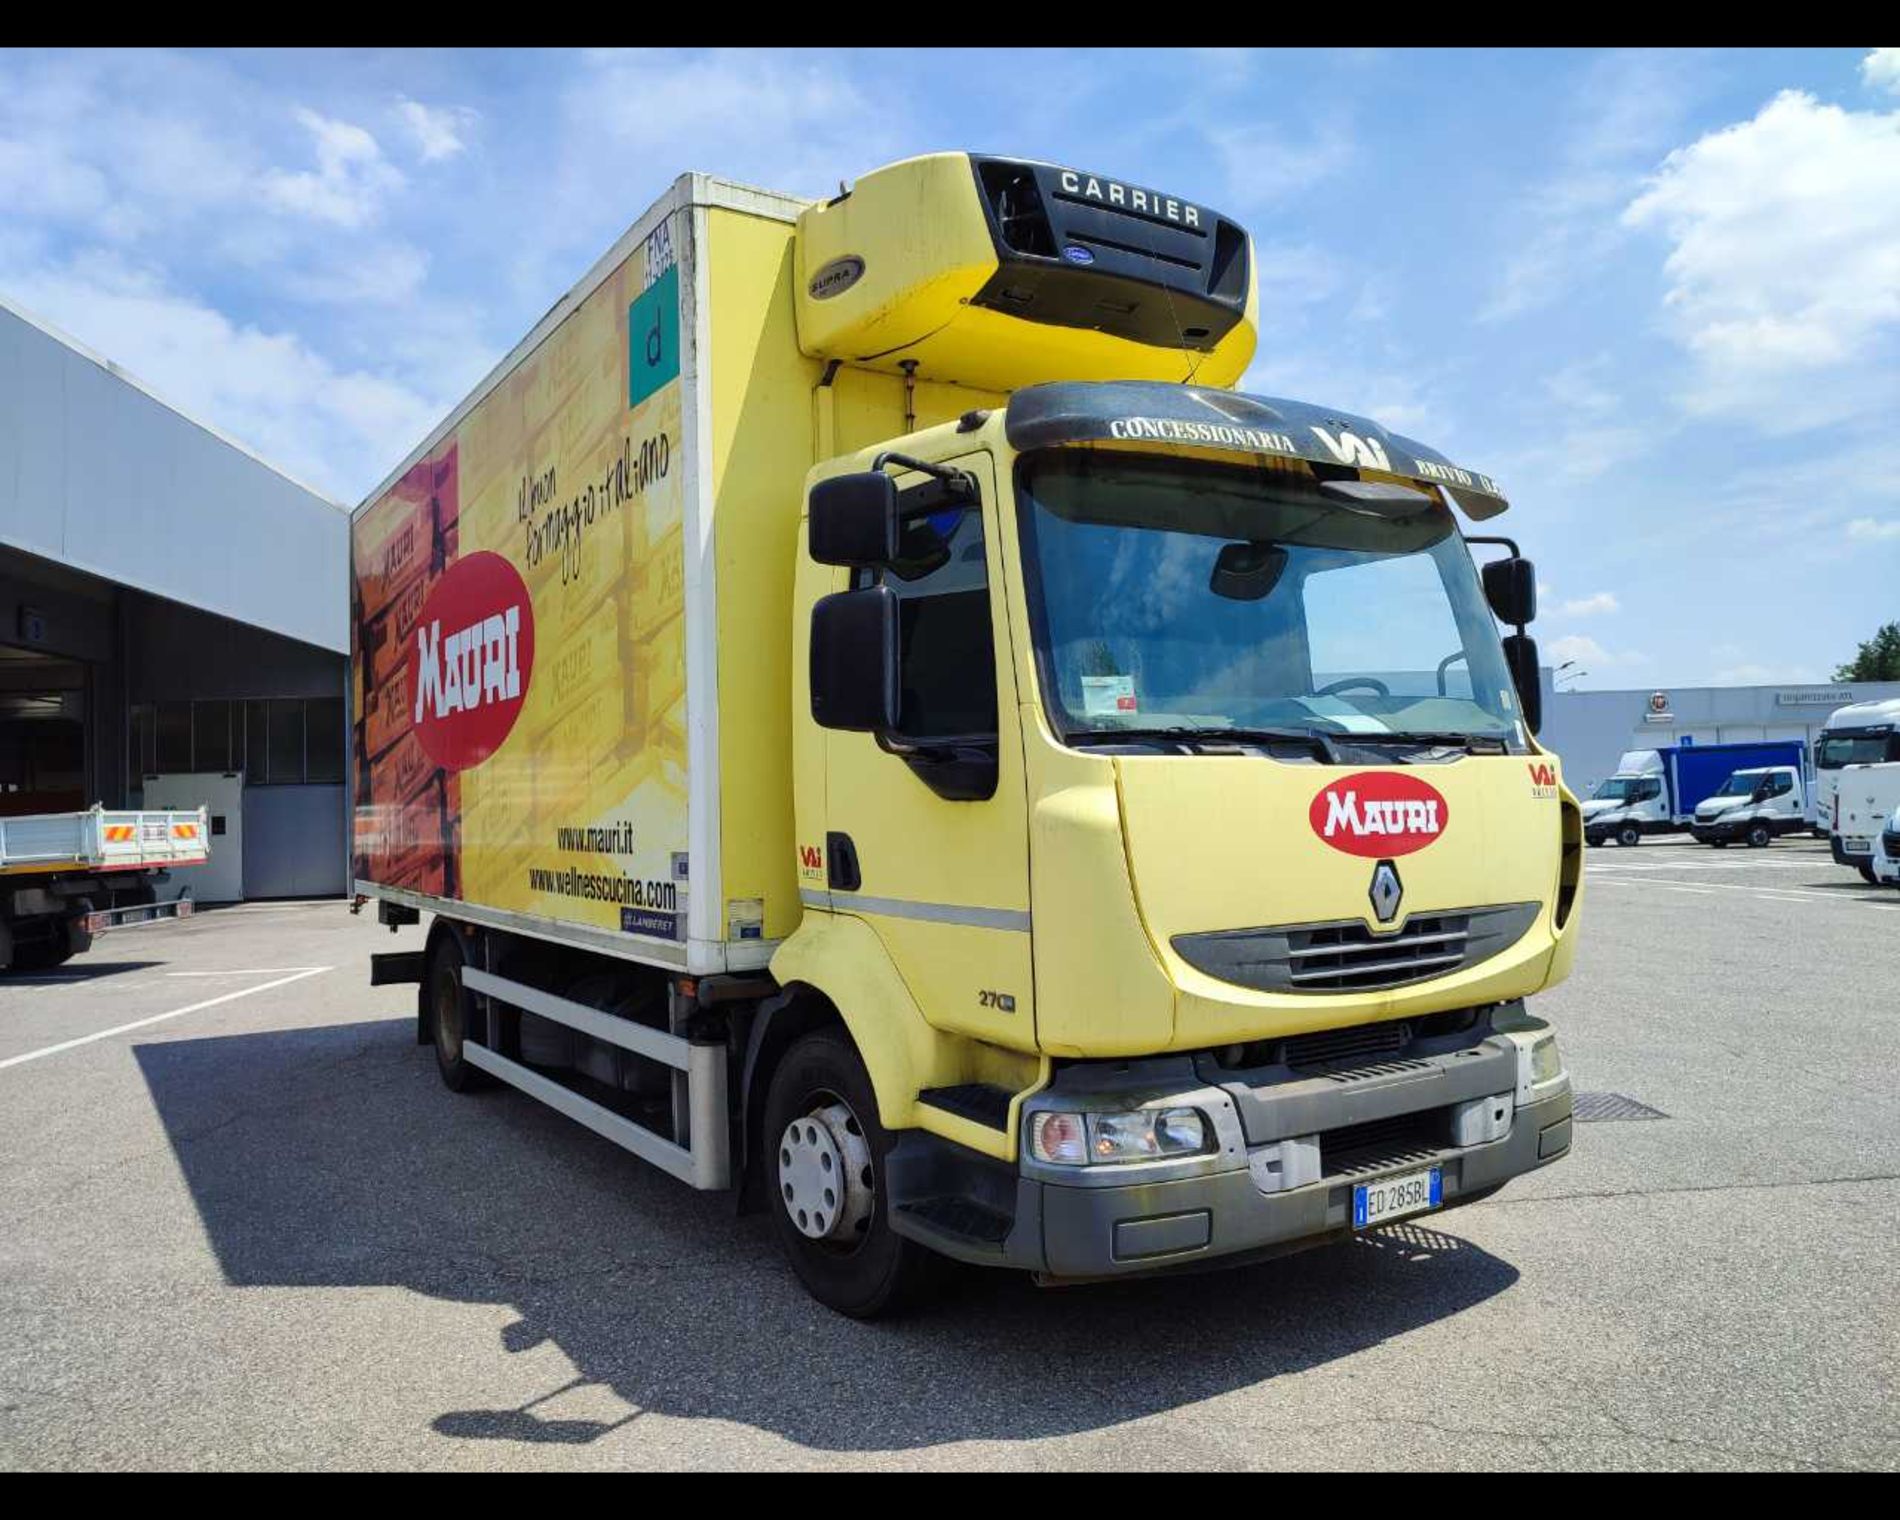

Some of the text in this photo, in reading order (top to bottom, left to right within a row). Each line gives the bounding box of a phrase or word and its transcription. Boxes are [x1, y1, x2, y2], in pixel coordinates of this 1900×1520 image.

[1061, 171, 1199, 226] CARRIER
[811, 268, 850, 293] SUPRA
[1110, 416, 1297, 453] CONCESSIONARIA
[526, 483, 595, 586] formaggio
[599, 432, 670, 518] italiano
[529, 466, 557, 514] buon
[415, 605, 521, 724] MAURI
[1324, 790, 1440, 837] MAURI
[557, 821, 633, 855] www.mauri.it
[529, 867, 677, 911] www.wellnesscucina.com
[1368, 1189, 1385, 1216] ED
[1389, 1179, 1429, 1211] 285BL
